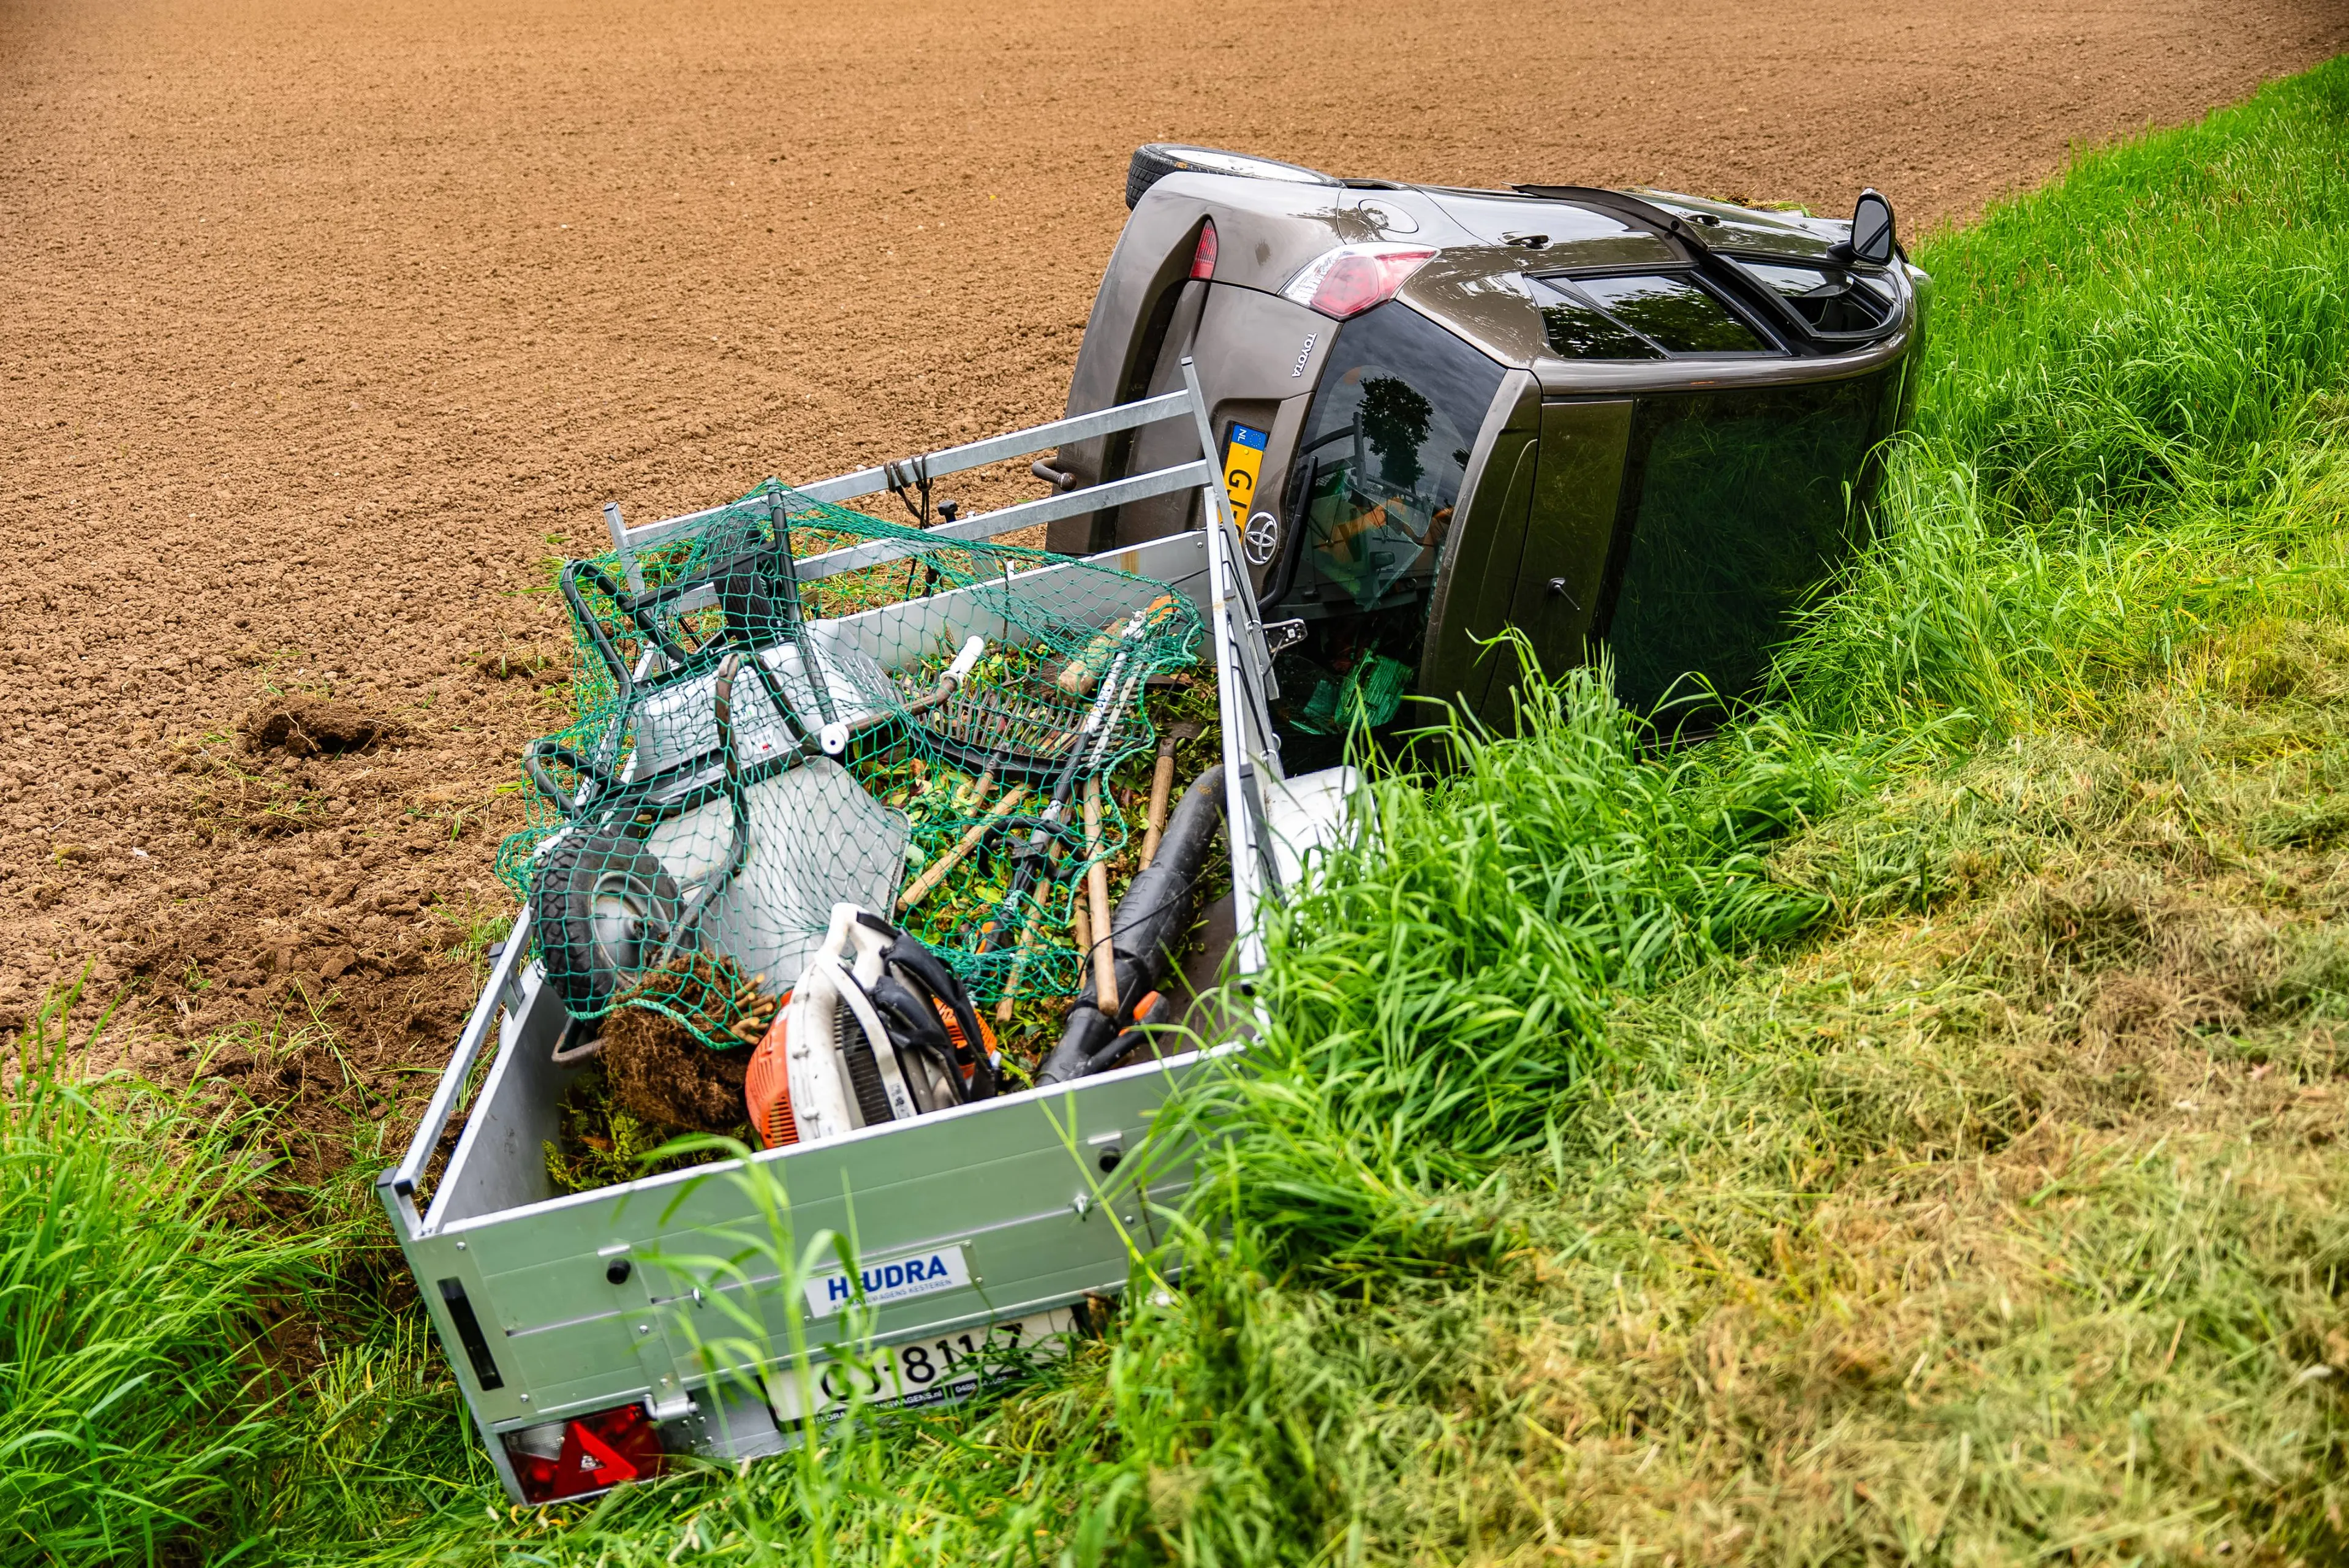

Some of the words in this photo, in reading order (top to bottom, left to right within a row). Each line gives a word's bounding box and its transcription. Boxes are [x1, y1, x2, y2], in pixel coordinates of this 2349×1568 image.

[1292, 333, 1317, 377] TOYOTA
[1237, 428, 1247, 442] NL
[828, 1254, 948, 1301] HUDRA
[909, 1279, 953, 1294] KESTEREN
